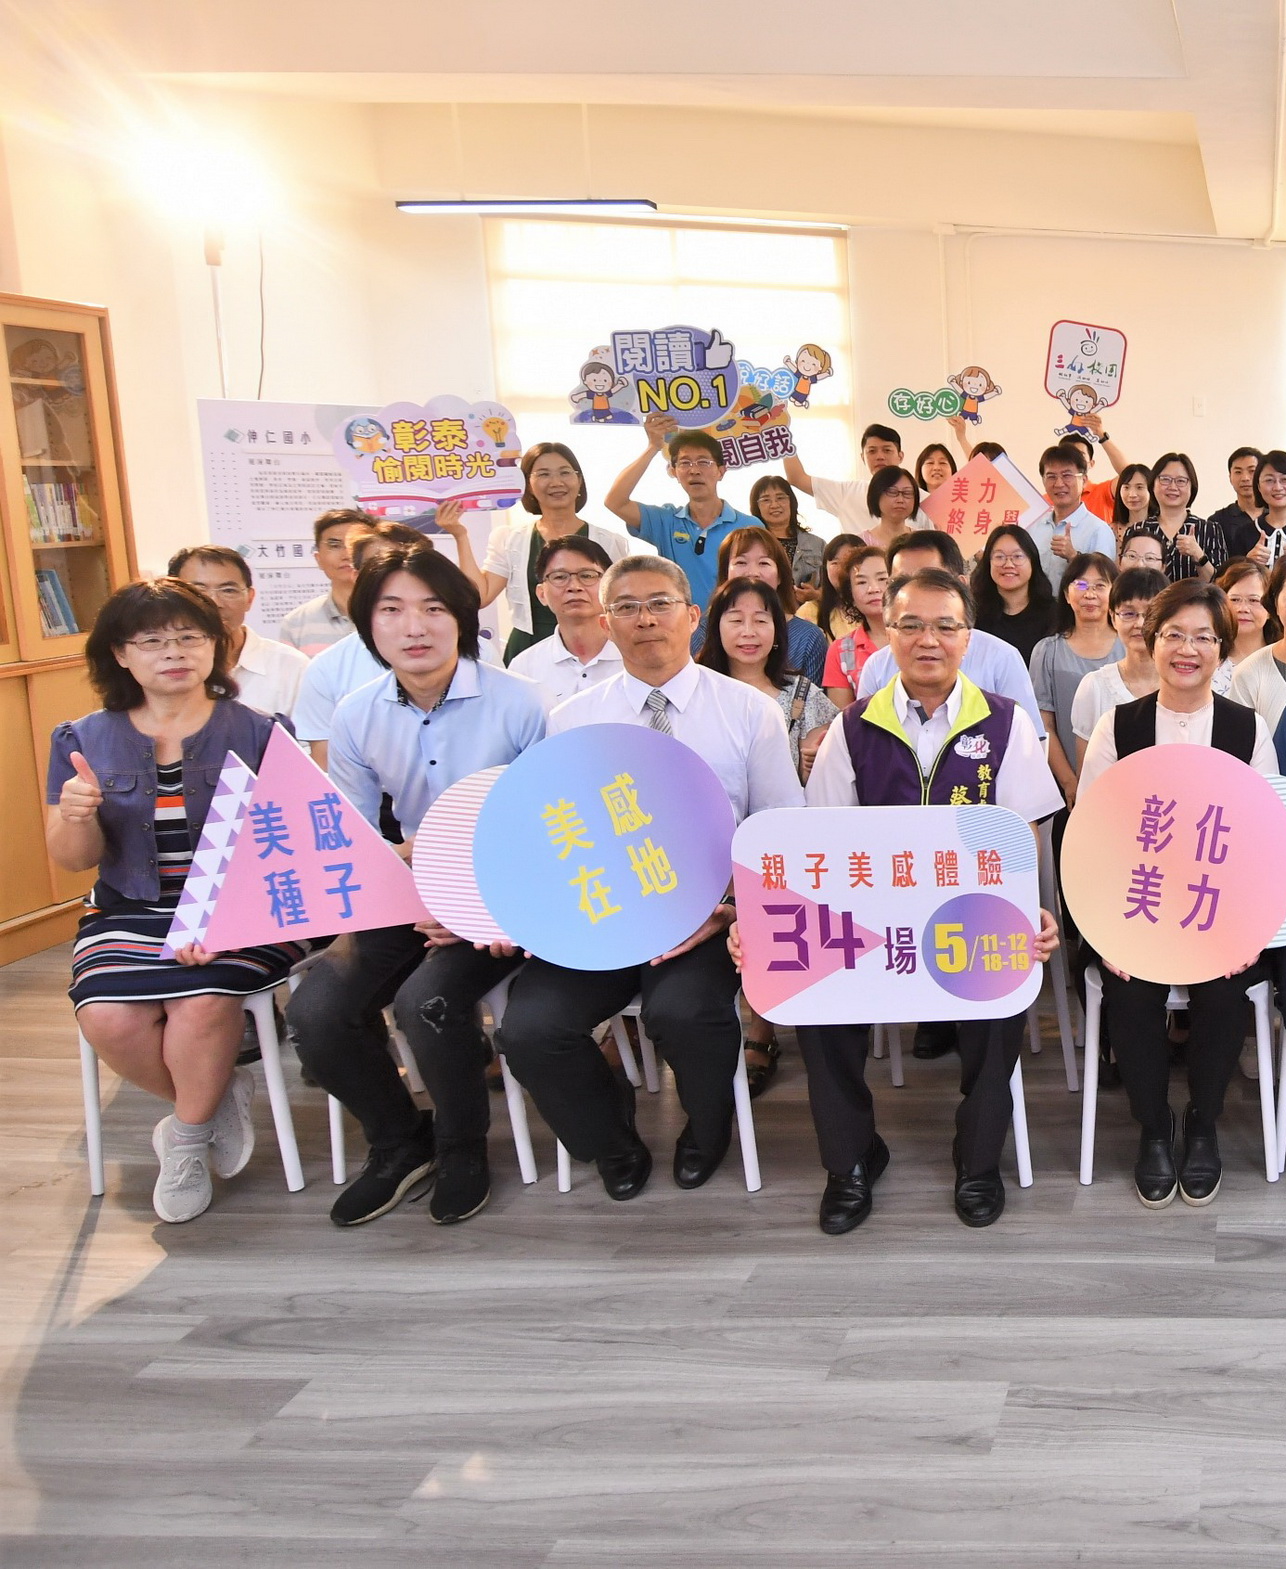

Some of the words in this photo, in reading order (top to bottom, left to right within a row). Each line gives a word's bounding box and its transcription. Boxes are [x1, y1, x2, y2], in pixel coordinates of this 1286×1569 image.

[613, 331, 695, 374] 閱讀
[637, 374, 728, 413] NO.1
[893, 393, 955, 414] 存好心
[391, 418, 468, 453] 彰泰
[372, 452, 496, 483] 愉閱時光
[951, 477, 996, 503] 美力
[257, 544, 318, 558] 大竹國
[977, 764, 992, 805] 教育
[247, 791, 352, 860] 美感
[540, 772, 653, 860] 美感
[1135, 794, 1231, 865] 彰化
[567, 837, 679, 925] 在地
[761, 850, 1003, 890] 親子美感體驗
[263, 862, 362, 929] 種子
[1123, 862, 1220, 933] 美力
[982, 952, 1029, 972] 18-19
